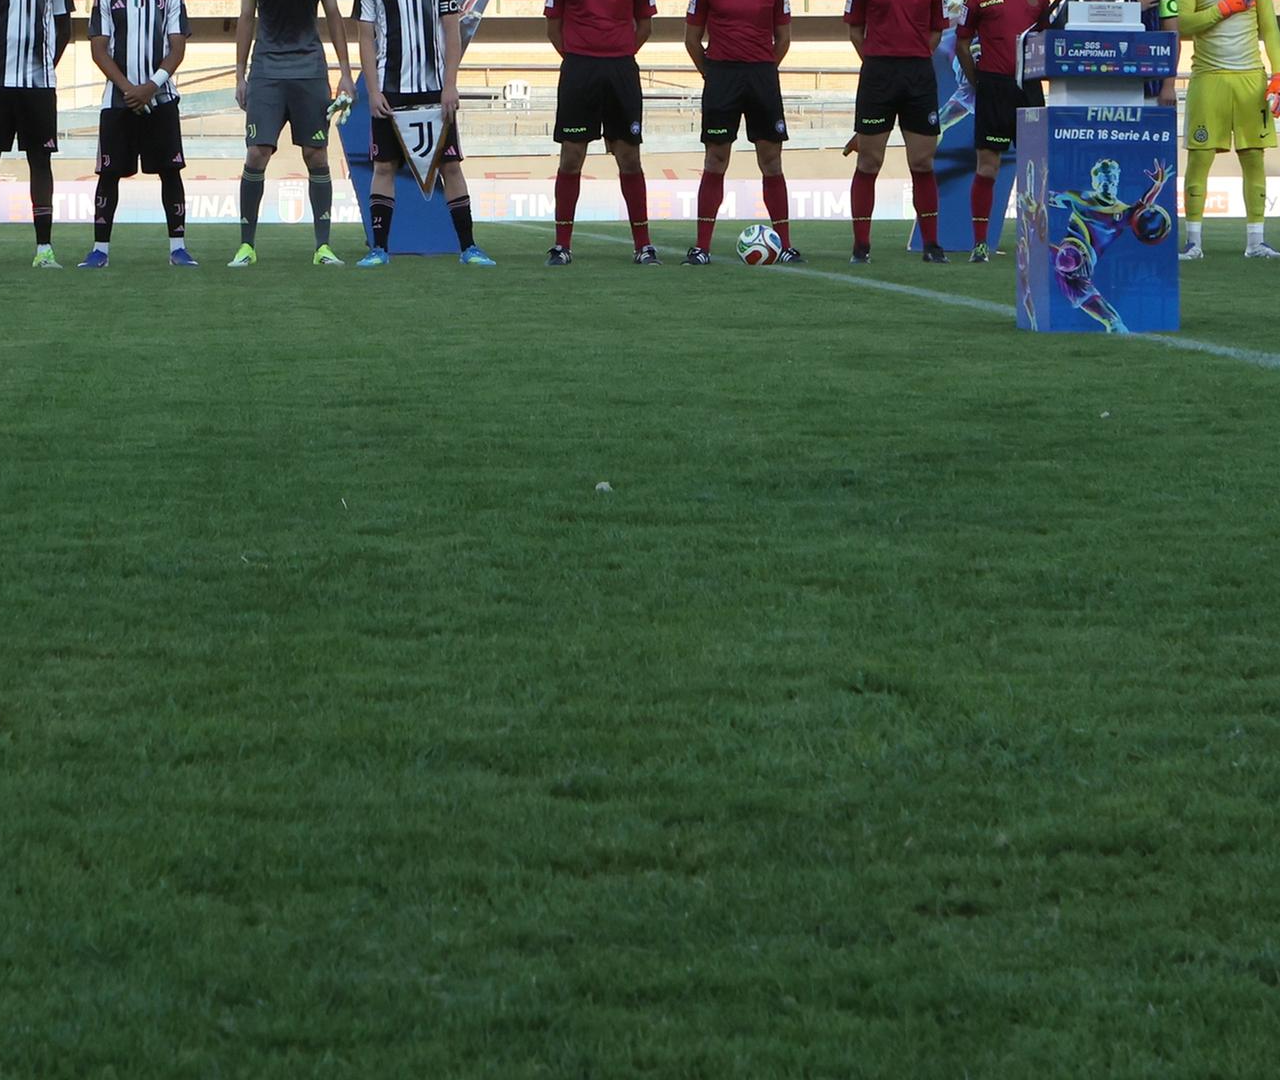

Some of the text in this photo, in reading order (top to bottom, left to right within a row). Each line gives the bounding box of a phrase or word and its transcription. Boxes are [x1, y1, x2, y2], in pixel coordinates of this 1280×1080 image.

[1068, 49, 1116, 58] CAMPIONATI
[1149, 45, 1171, 56] TIM
[1086, 106, 1142, 122] FINALI
[1260, 109, 1267, 128] 1
[1054, 129, 1171, 142] UNDER 16 Serie A e B
[510, 193, 556, 217] TIM
[676, 191, 736, 218] TM
[791, 191, 851, 218] TIM
